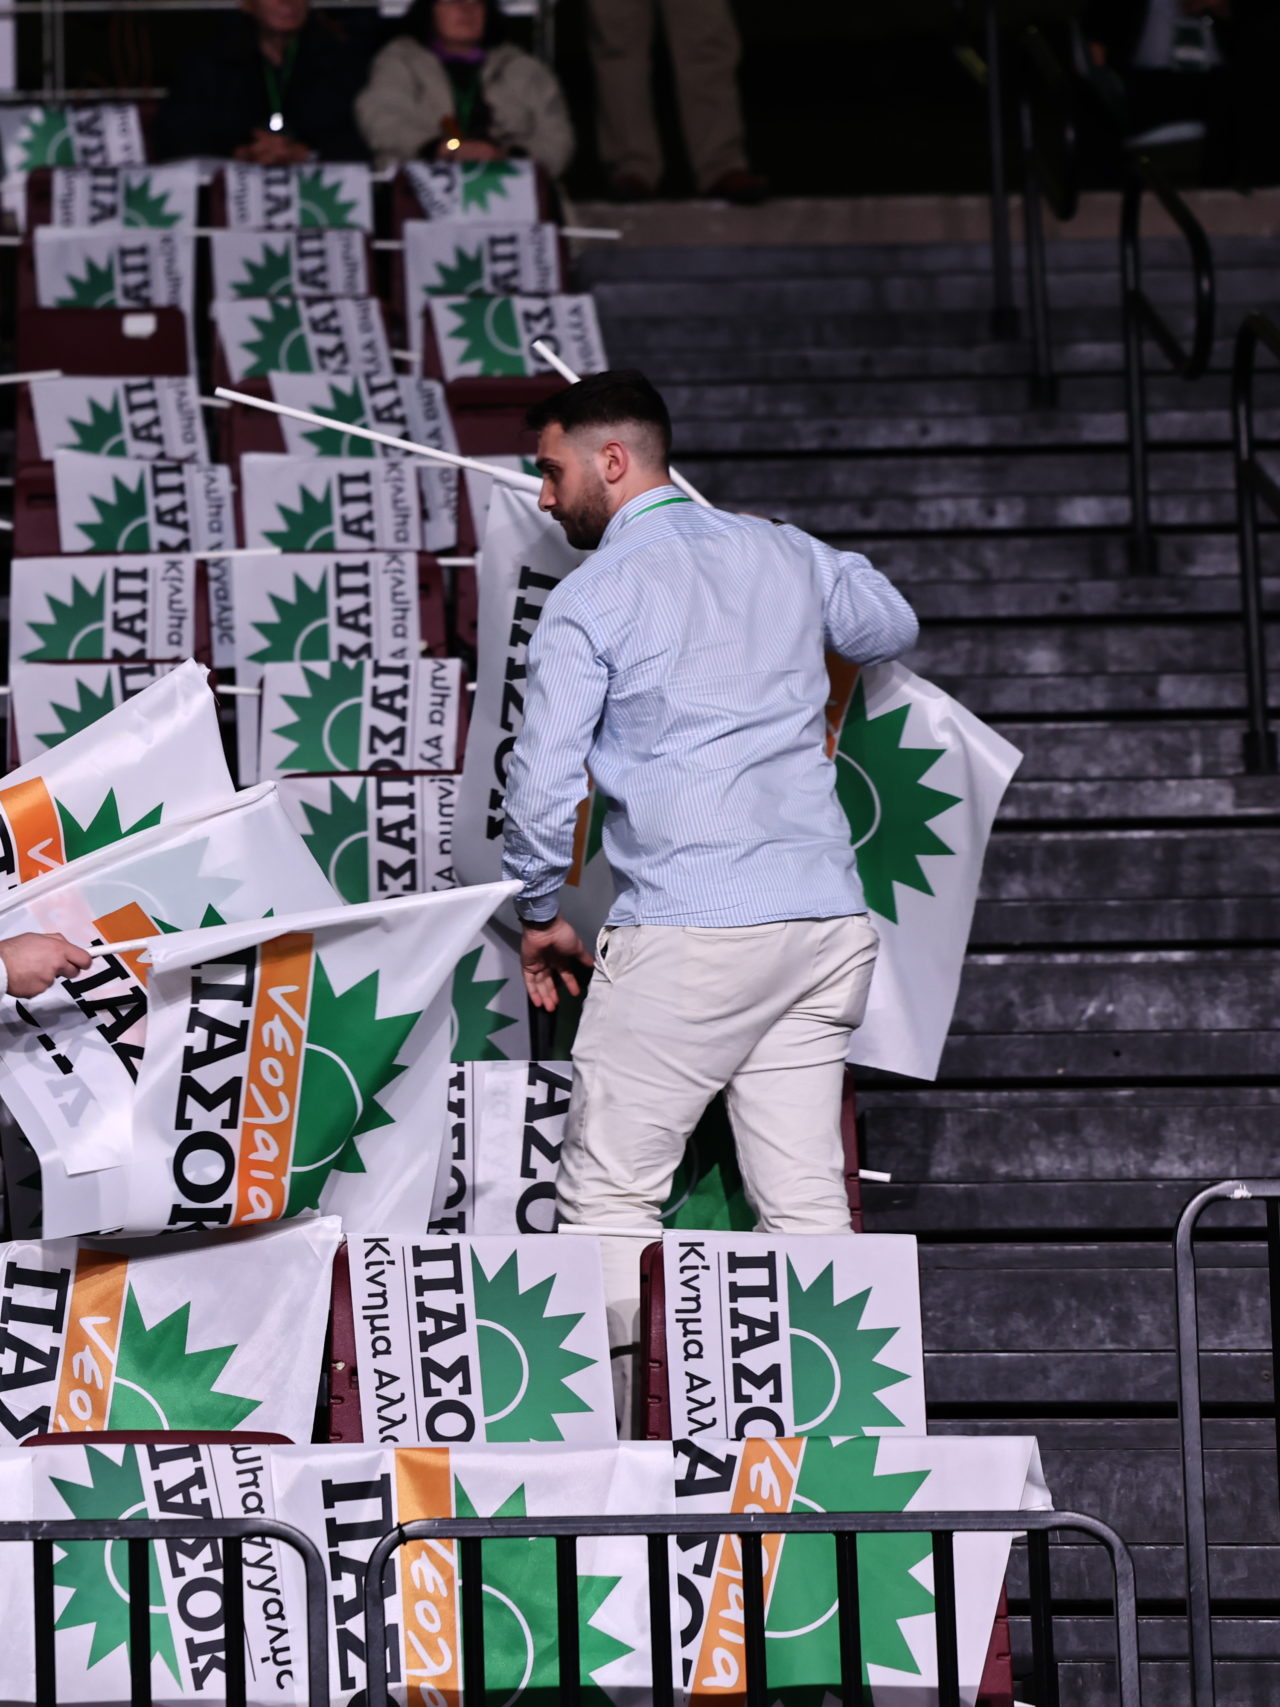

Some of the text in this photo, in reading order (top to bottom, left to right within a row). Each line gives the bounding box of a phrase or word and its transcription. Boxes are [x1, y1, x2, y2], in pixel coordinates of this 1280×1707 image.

[360, 1236, 396, 1359] Κίνημα
[411, 1242, 476, 1442] ΠΑΣΟ
[674, 1240, 712, 1362] Κίνημα
[320, 1472, 404, 1707] ΠΑΣ
